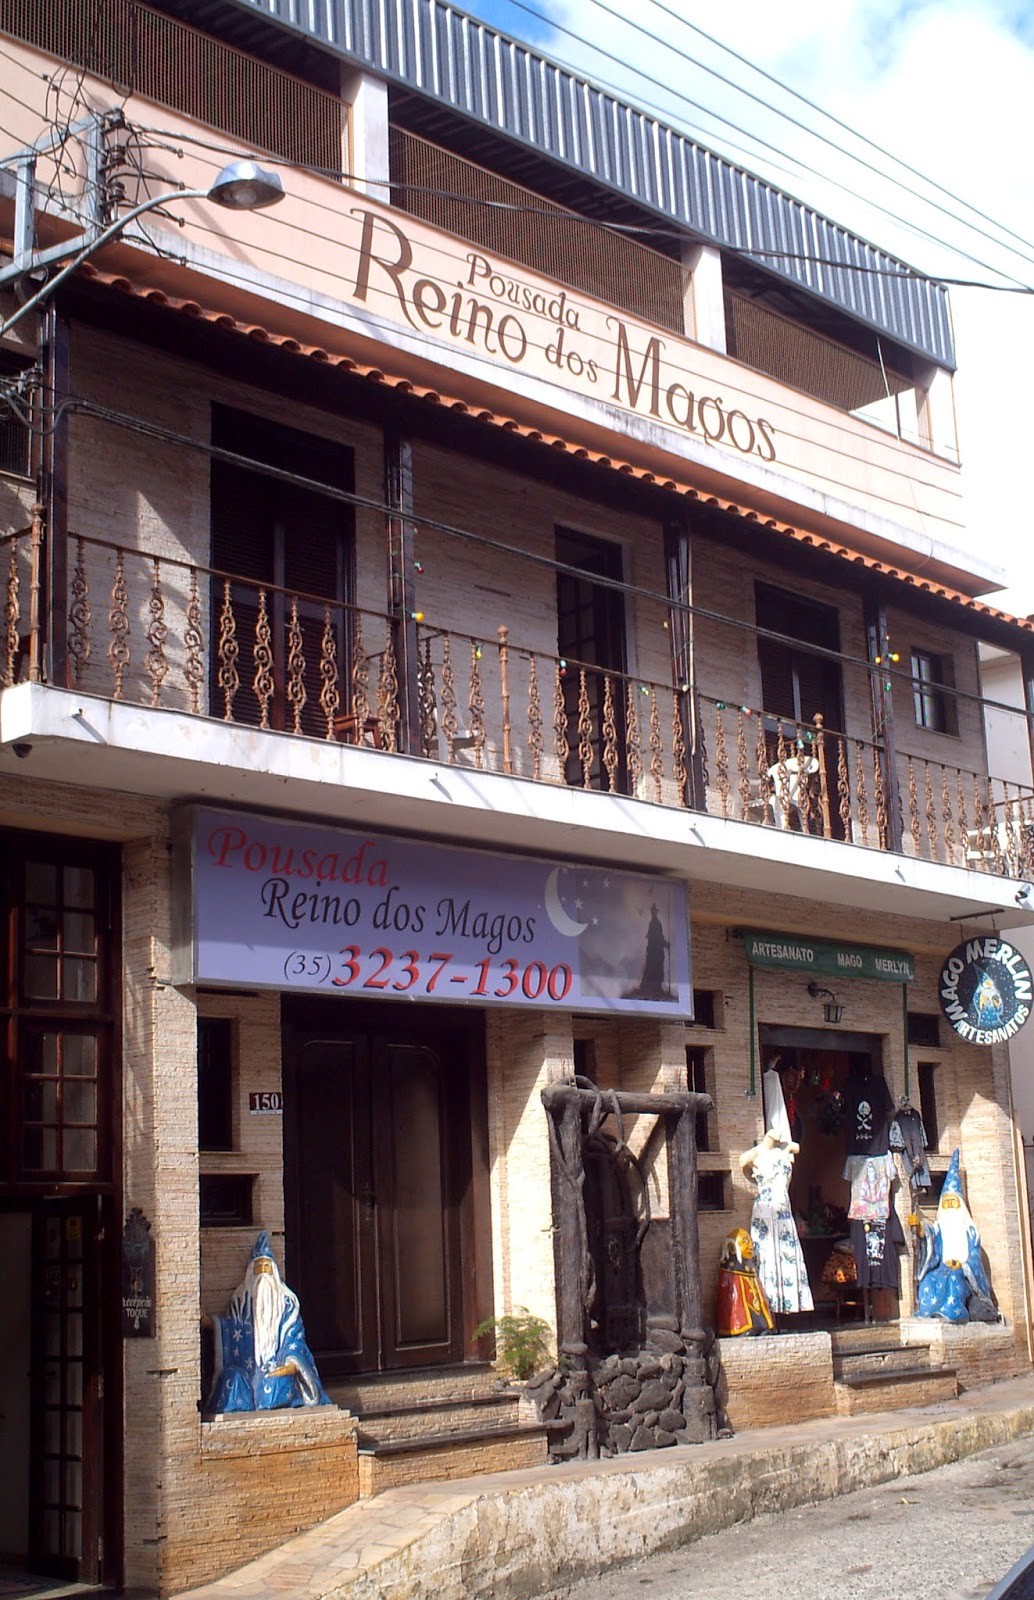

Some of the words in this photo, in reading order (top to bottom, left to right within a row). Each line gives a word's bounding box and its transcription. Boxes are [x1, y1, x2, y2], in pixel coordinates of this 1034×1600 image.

[466, 253, 581, 331] Pousada
[350, 207, 528, 363] Reino
[545, 327, 599, 384] dos
[606, 316, 777, 462] Magos
[207, 825, 390, 887] Pousada
[261, 877, 362, 929] Reino
[373, 886, 426, 933] dos
[435, 898, 537, 955] Magos
[283, 950, 332, 984] (35)
[331, 944, 573, 1001] 3237-1300
[752, 941, 815, 963] ARTESANATO
[837, 952, 863, 969] MAGO
[875, 957, 910, 976] MERLYN
[941, 957, 969, 1021] MAGO
[965, 938, 1033, 1001] MERLIN
[953, 1004, 1030, 1044] ARTESANATOS
[253, 1093, 280, 1110] 150
[125, 1307, 149, 1319] TOQUE
